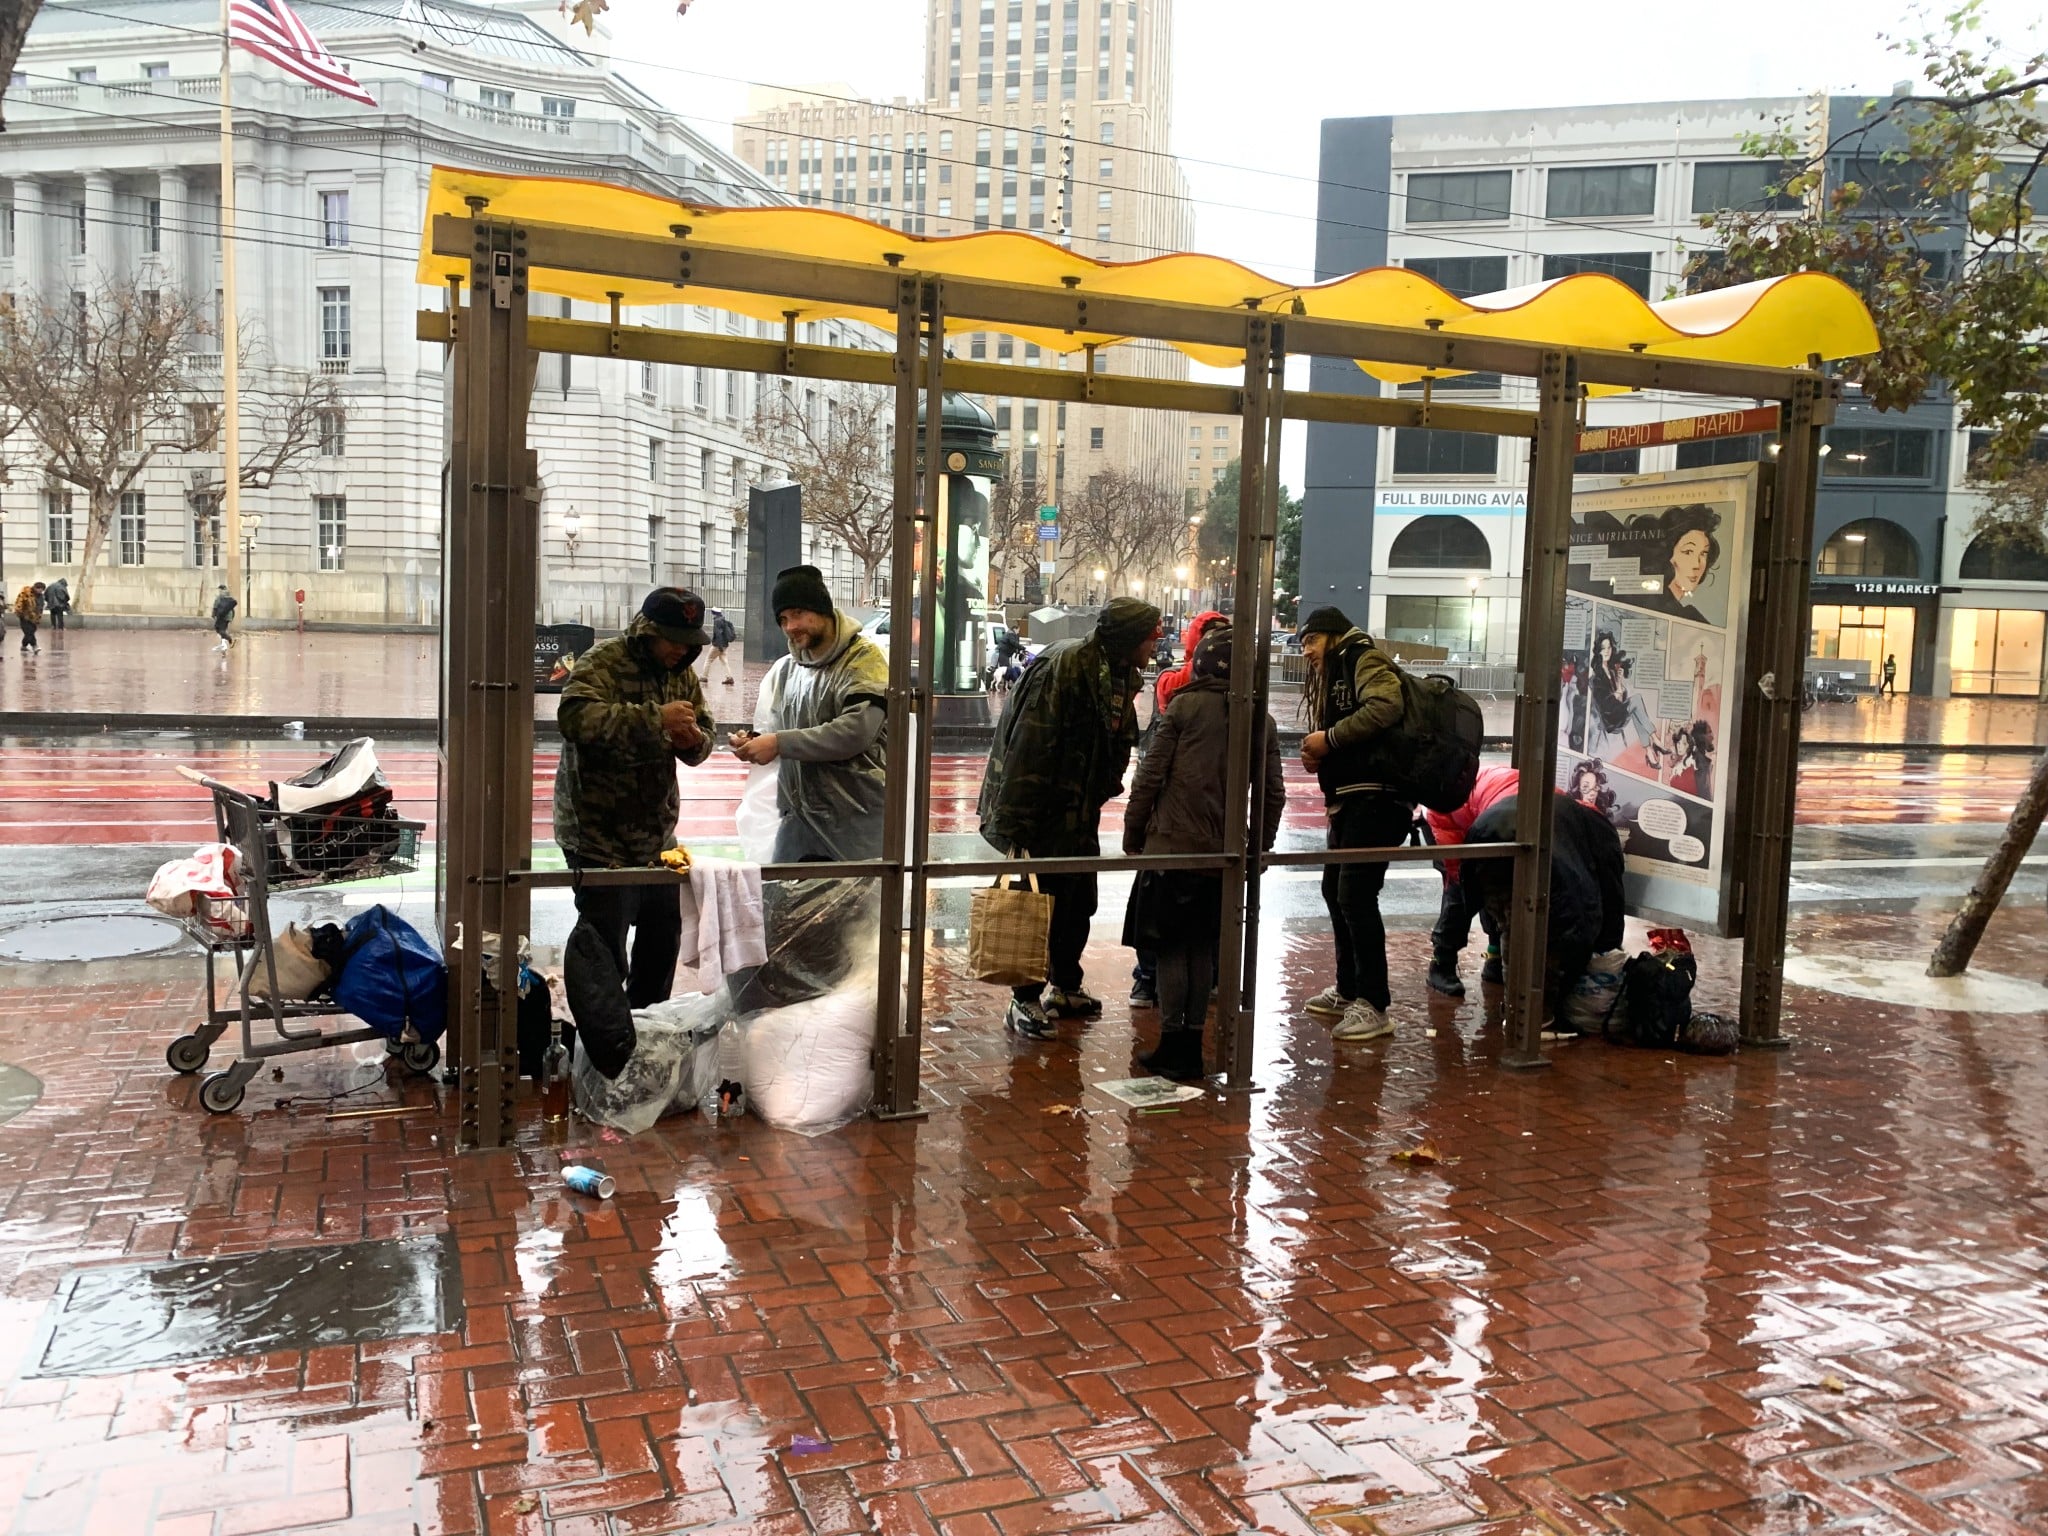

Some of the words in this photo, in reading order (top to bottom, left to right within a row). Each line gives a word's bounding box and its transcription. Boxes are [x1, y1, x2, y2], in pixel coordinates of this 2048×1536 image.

[1695, 411, 1744, 437] RAPID
[1609, 424, 1650, 449] RAPID
[1382, 492, 1416, 505] FULL
[1420, 493, 1487, 505] BUILDING
[1855, 584, 1883, 592] 1128
[1886, 584, 1939, 594] MARKET
